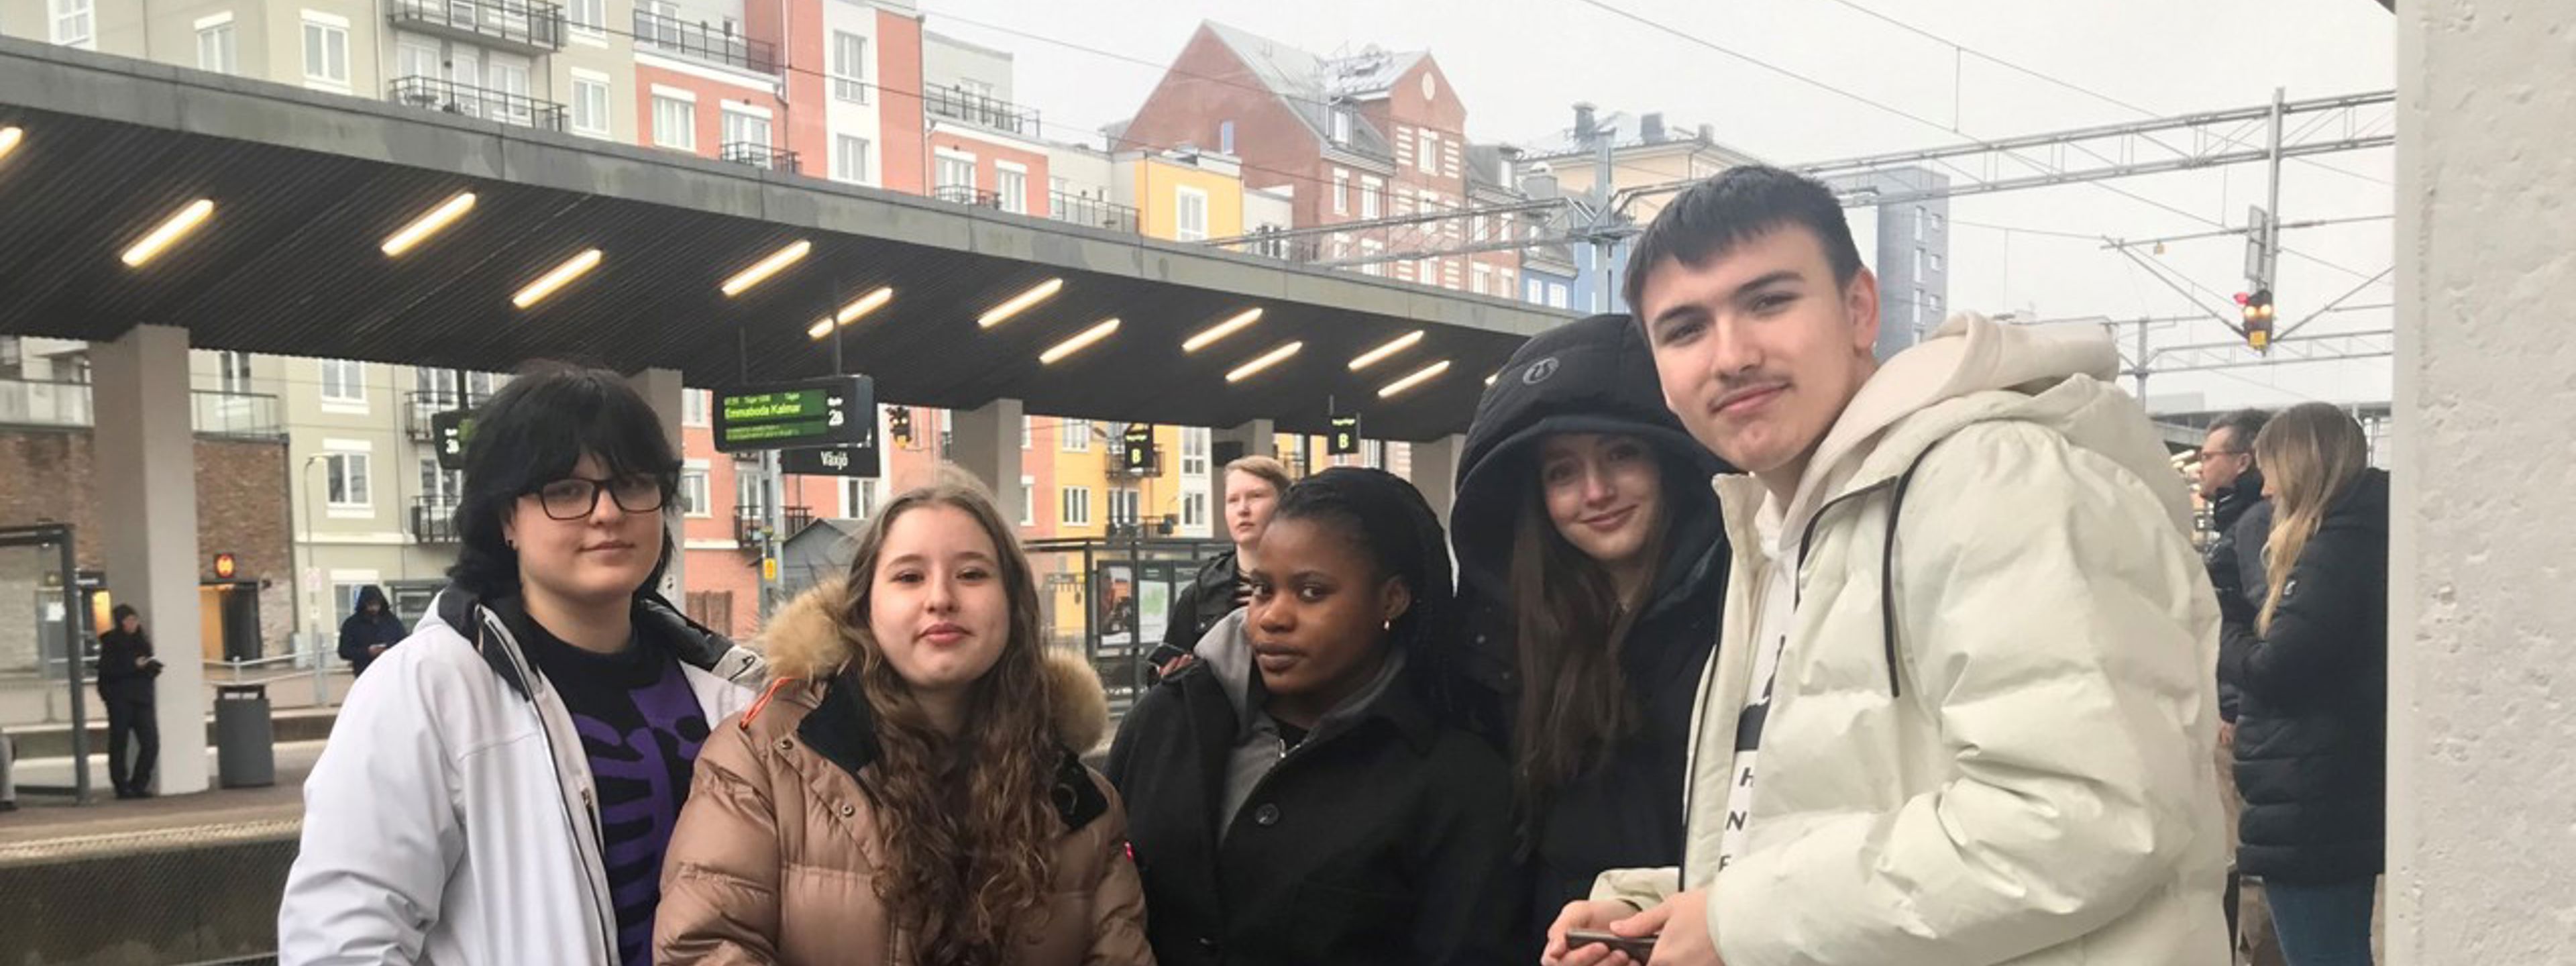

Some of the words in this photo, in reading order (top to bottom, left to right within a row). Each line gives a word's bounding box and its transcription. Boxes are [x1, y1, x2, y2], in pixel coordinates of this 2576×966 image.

[724, 406, 769, 420] Emmaboda
[771, 402, 801, 415] Kalmar
[1339, 433, 1349, 450] B
[820, 451, 849, 471] Växjö
[1132, 448, 1142, 464] B
[1726, 810, 1747, 832] N
